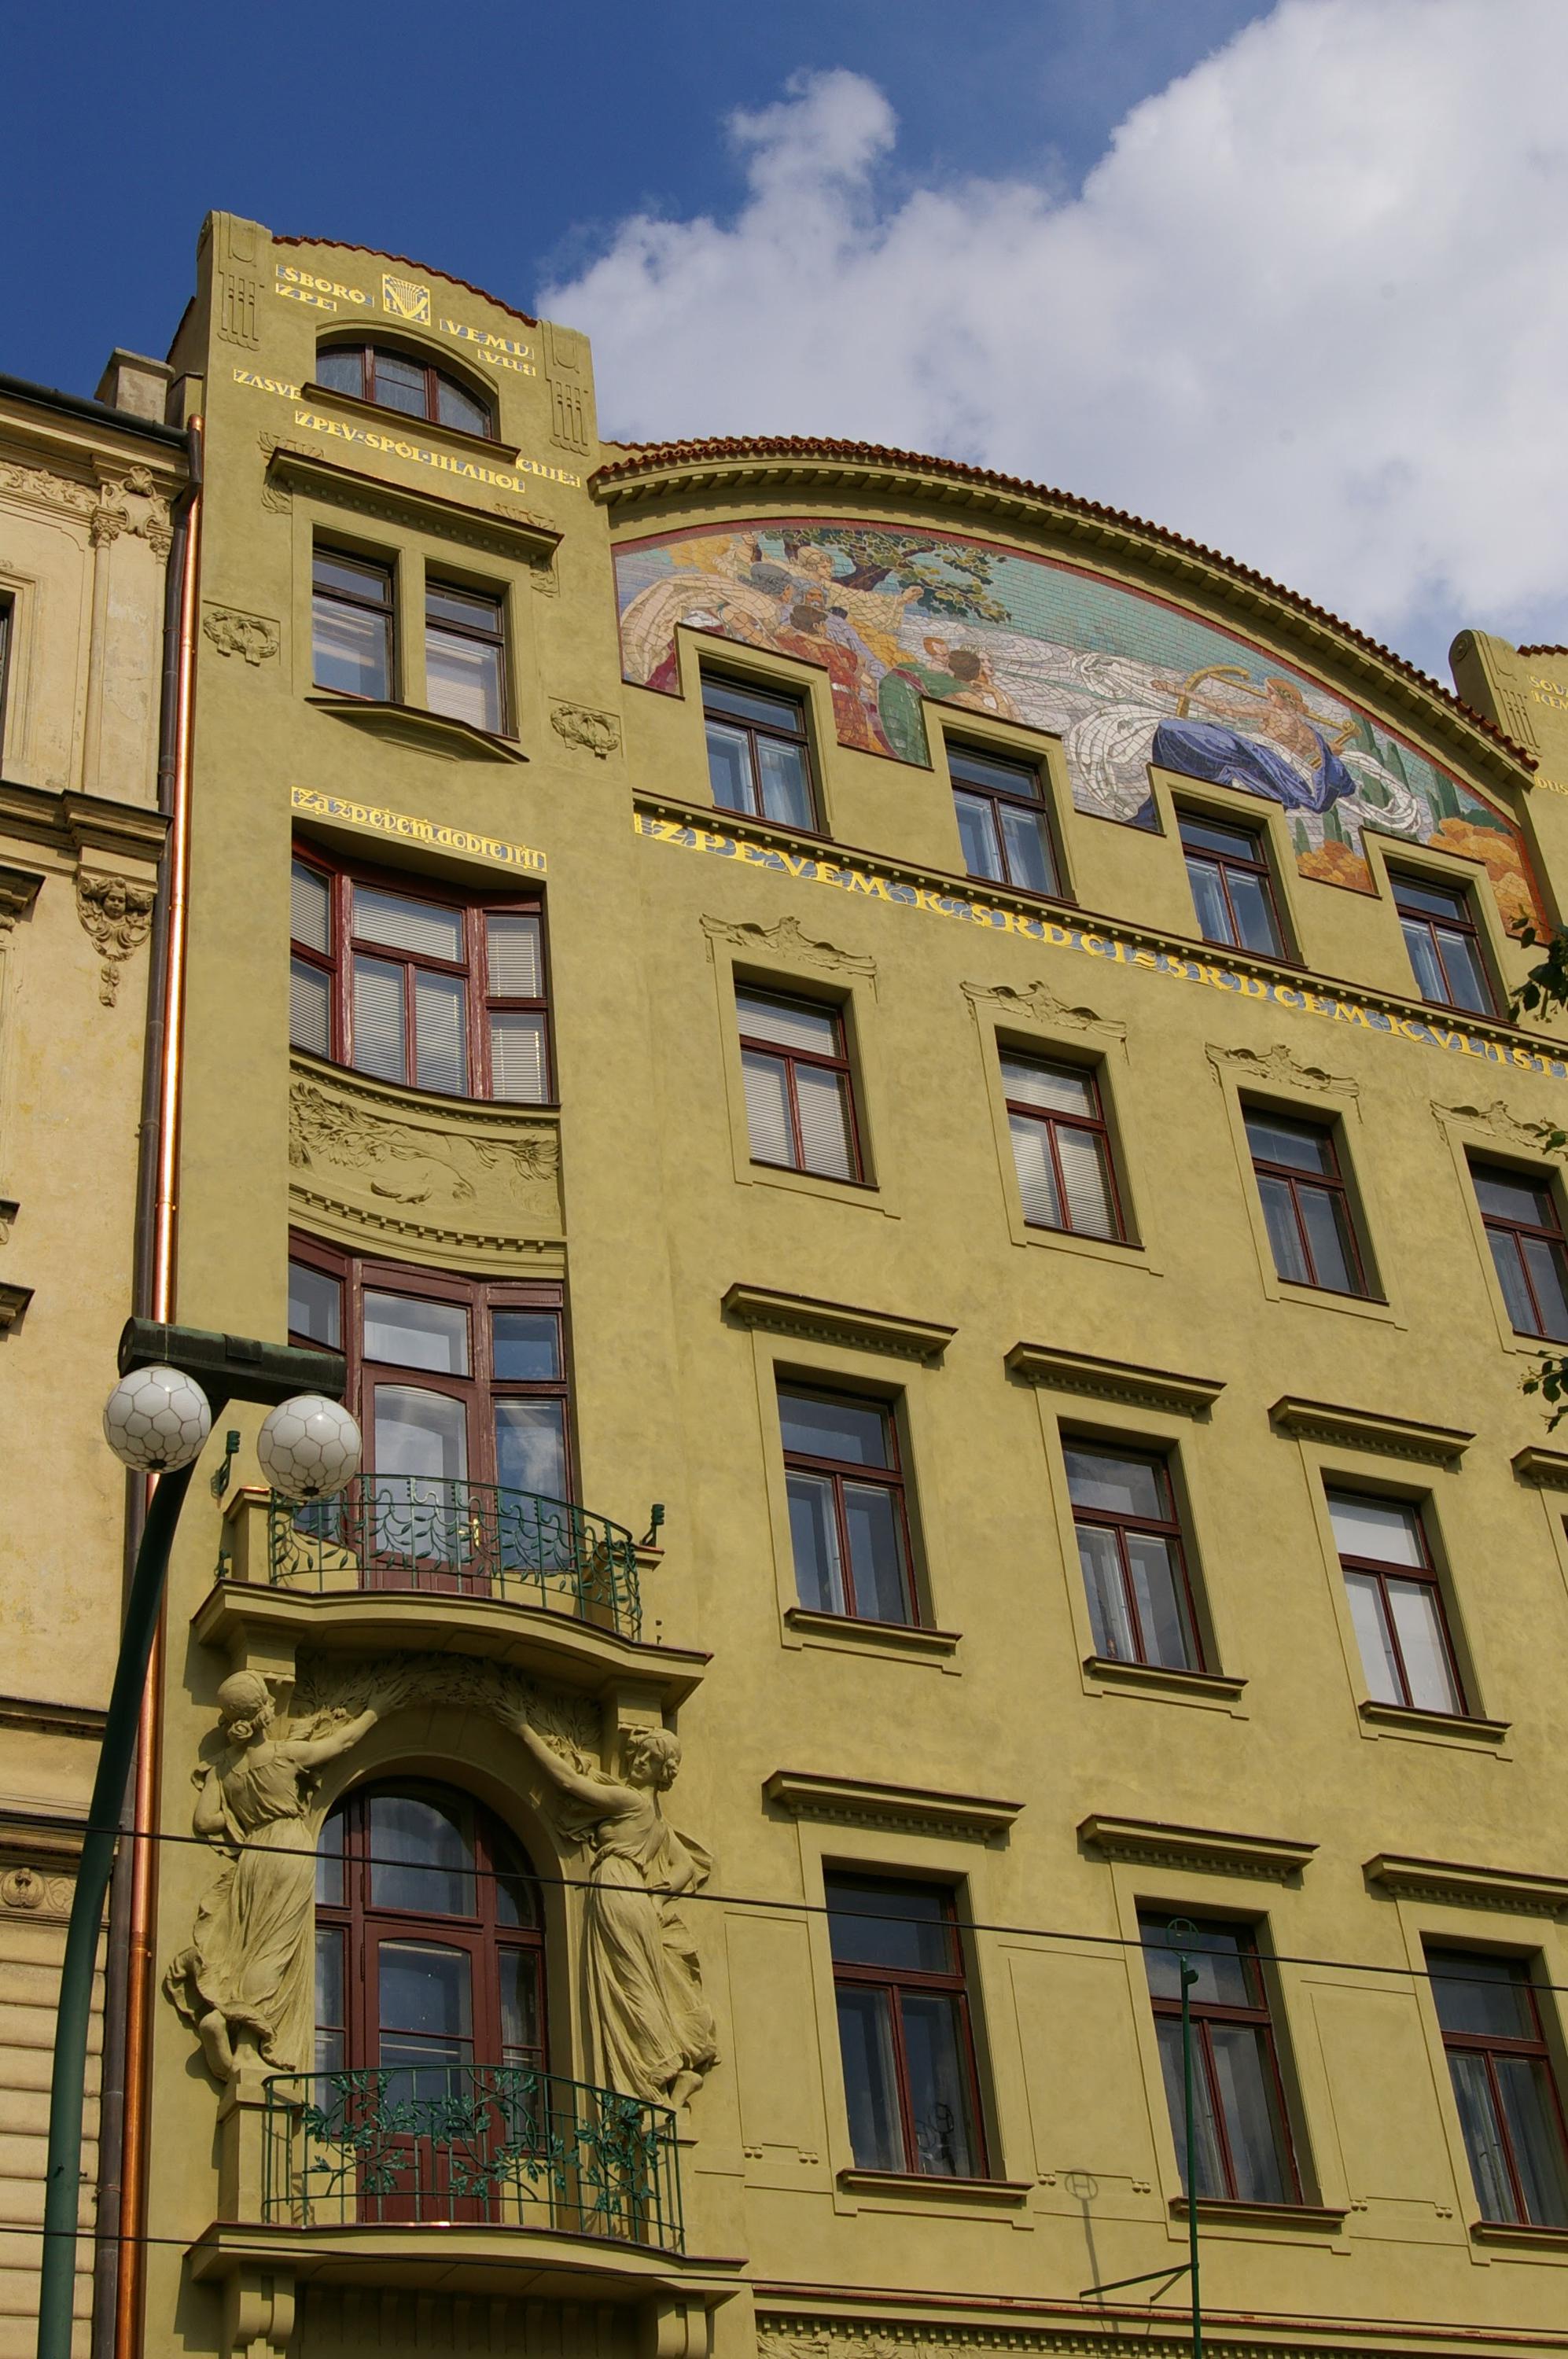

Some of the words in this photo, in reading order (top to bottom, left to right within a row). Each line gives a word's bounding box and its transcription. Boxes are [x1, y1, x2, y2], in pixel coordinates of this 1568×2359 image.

[915, 888, 954, 917] K
[971, 903, 1127, 963] SRDCI
[1167, 955, 1372, 1029] SRDCEM
[1386, 1013, 1425, 1042] K
